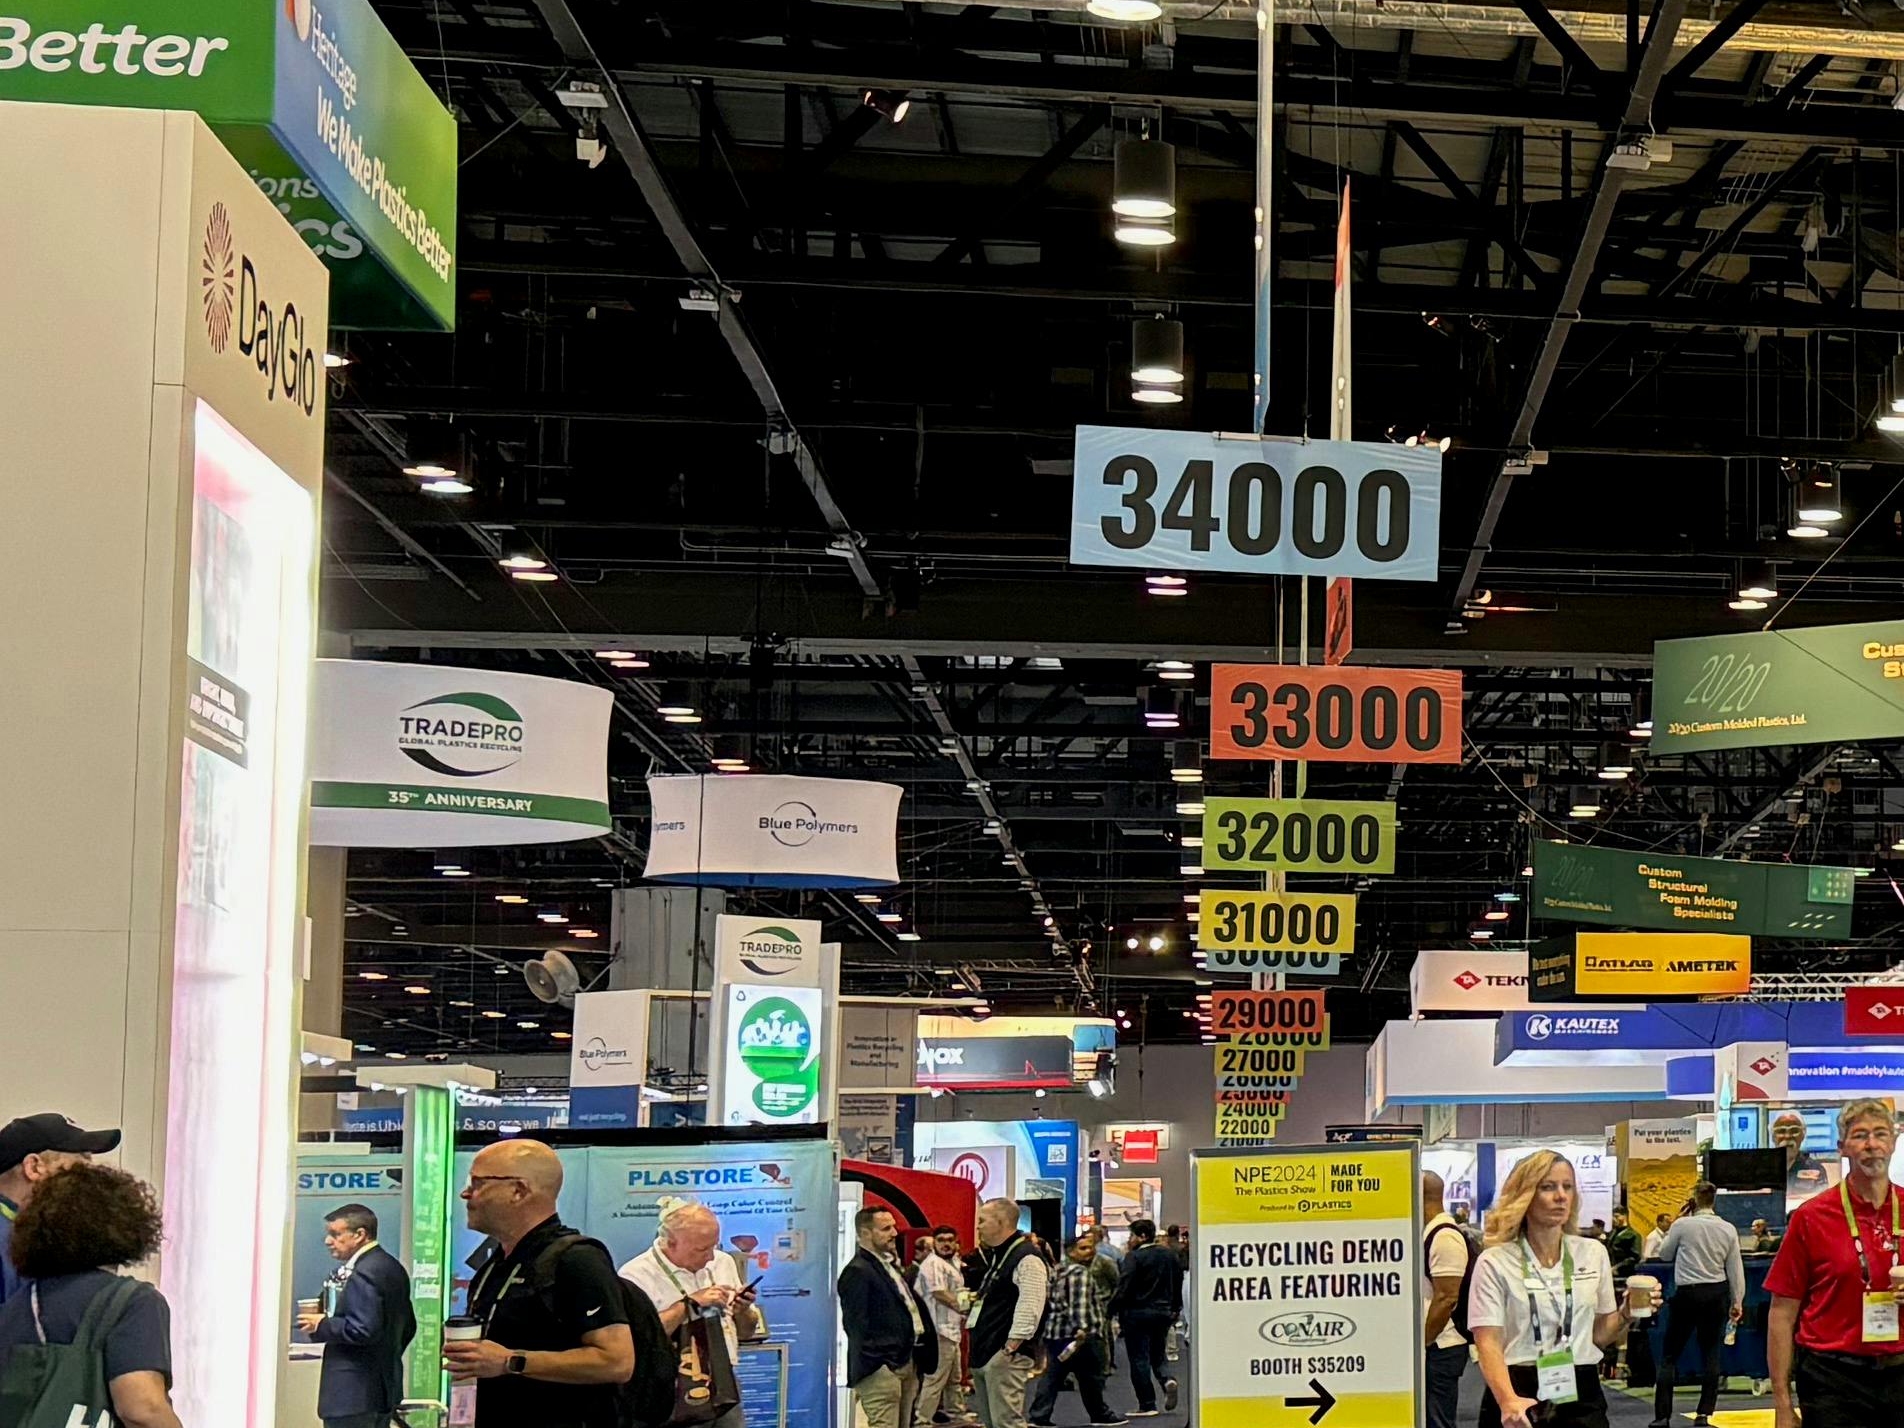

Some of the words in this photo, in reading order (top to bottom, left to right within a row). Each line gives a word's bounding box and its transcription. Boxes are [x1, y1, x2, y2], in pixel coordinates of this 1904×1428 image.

[311, 5, 357, 110] Heritage
[317, 86, 337, 154] We
[338, 116, 371, 194] Make
[372, 156, 417, 246] Plastics
[417, 209, 451, 283] Better
[240, 255, 315, 417] DayGlo
[1100, 454, 1410, 562] 34000
[1684, 653, 1771, 712] 20/20
[1230, 682, 1441, 751] 33000
[1691, 721, 1722, 732] Custom
[1724, 717, 1757, 730] Molded
[400, 716, 523, 743] TRADEPRO
[425, 792, 533, 813] ANNIVERSARY
[759, 817, 792, 830] Blue
[796, 818, 858, 835] Polymers
[1217, 811, 1379, 864] 32000
[1638, 864, 1682, 878] Custom
[1649, 879, 1707, 893] Structural
[1660, 893, 1690, 905] Foam
[1694, 898, 1737, 910] Molding
[1214, 901, 1339, 944] 31000
[1674, 907, 1734, 920] Specialists
[740, 941, 802, 956] TRADEPRO
[1666, 960, 1739, 972] AMETEK
[1219, 998, 1316, 1029] 29000
[1556, 1018, 1620, 1029] KAUTEX
[1222, 1049, 1296, 1072] 27000
[1222, 1103, 1279, 1117] 24000
[464, 1119, 474, 1131] &
[477, 1120, 496, 1131] so
[1220, 1120, 1270, 1134] 22000
[629, 1168, 752, 1186] PLASTORE
[1234, 1165, 1316, 1183] NPE2024
[1330, 1163, 1363, 1177] MADE
[1235, 1186, 1252, 1196] The
[1254, 1184, 1289, 1196] Plastics
[1290, 1184, 1316, 1195] Show
[1331, 1179, 1353, 1193] FOR
[1356, 1178, 1380, 1192] YOU
[1311, 1200, 1352, 1211] PLASTICS
[1210, 1241, 1334, 1269] RECYCLING
[1342, 1238, 1404, 1264] DEMO
[1213, 1275, 1272, 1302] AREA
[1280, 1272, 1401, 1300] FEATURING
[1271, 1315, 1345, 1338] CONAIR
[1250, 1357, 1302, 1376] BOOTH
[1307, 1356, 1365, 1374] S35209
